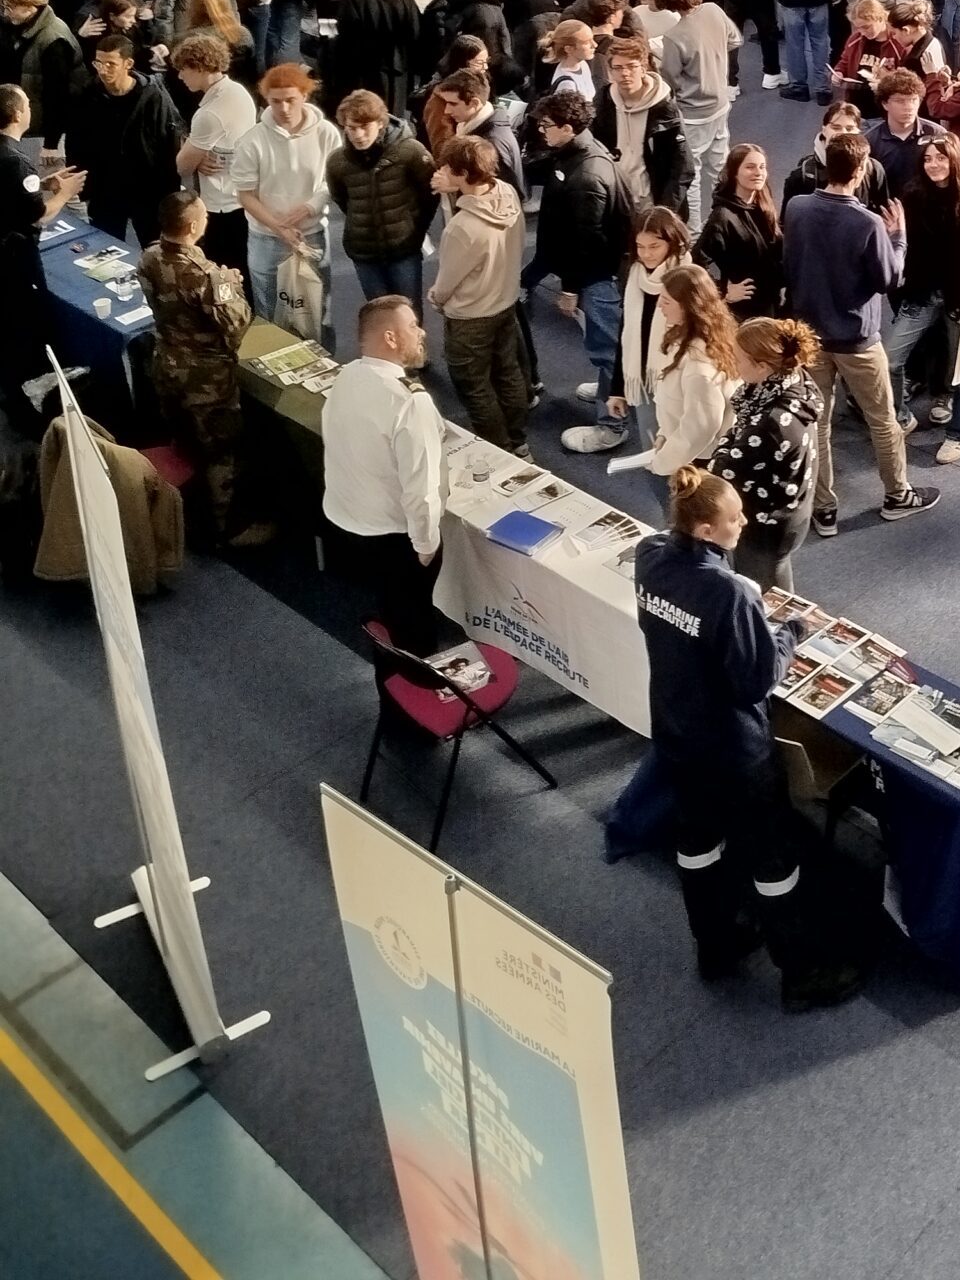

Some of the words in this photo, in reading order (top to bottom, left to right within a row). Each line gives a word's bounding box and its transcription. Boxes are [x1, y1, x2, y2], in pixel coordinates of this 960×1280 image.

[646, 592, 660, 608] LA
[660, 598, 702, 629] MARINE
[472, 616, 490, 629] DE
[544, 650, 590, 689] RECRUTE
[531, 631, 546, 647] DE
